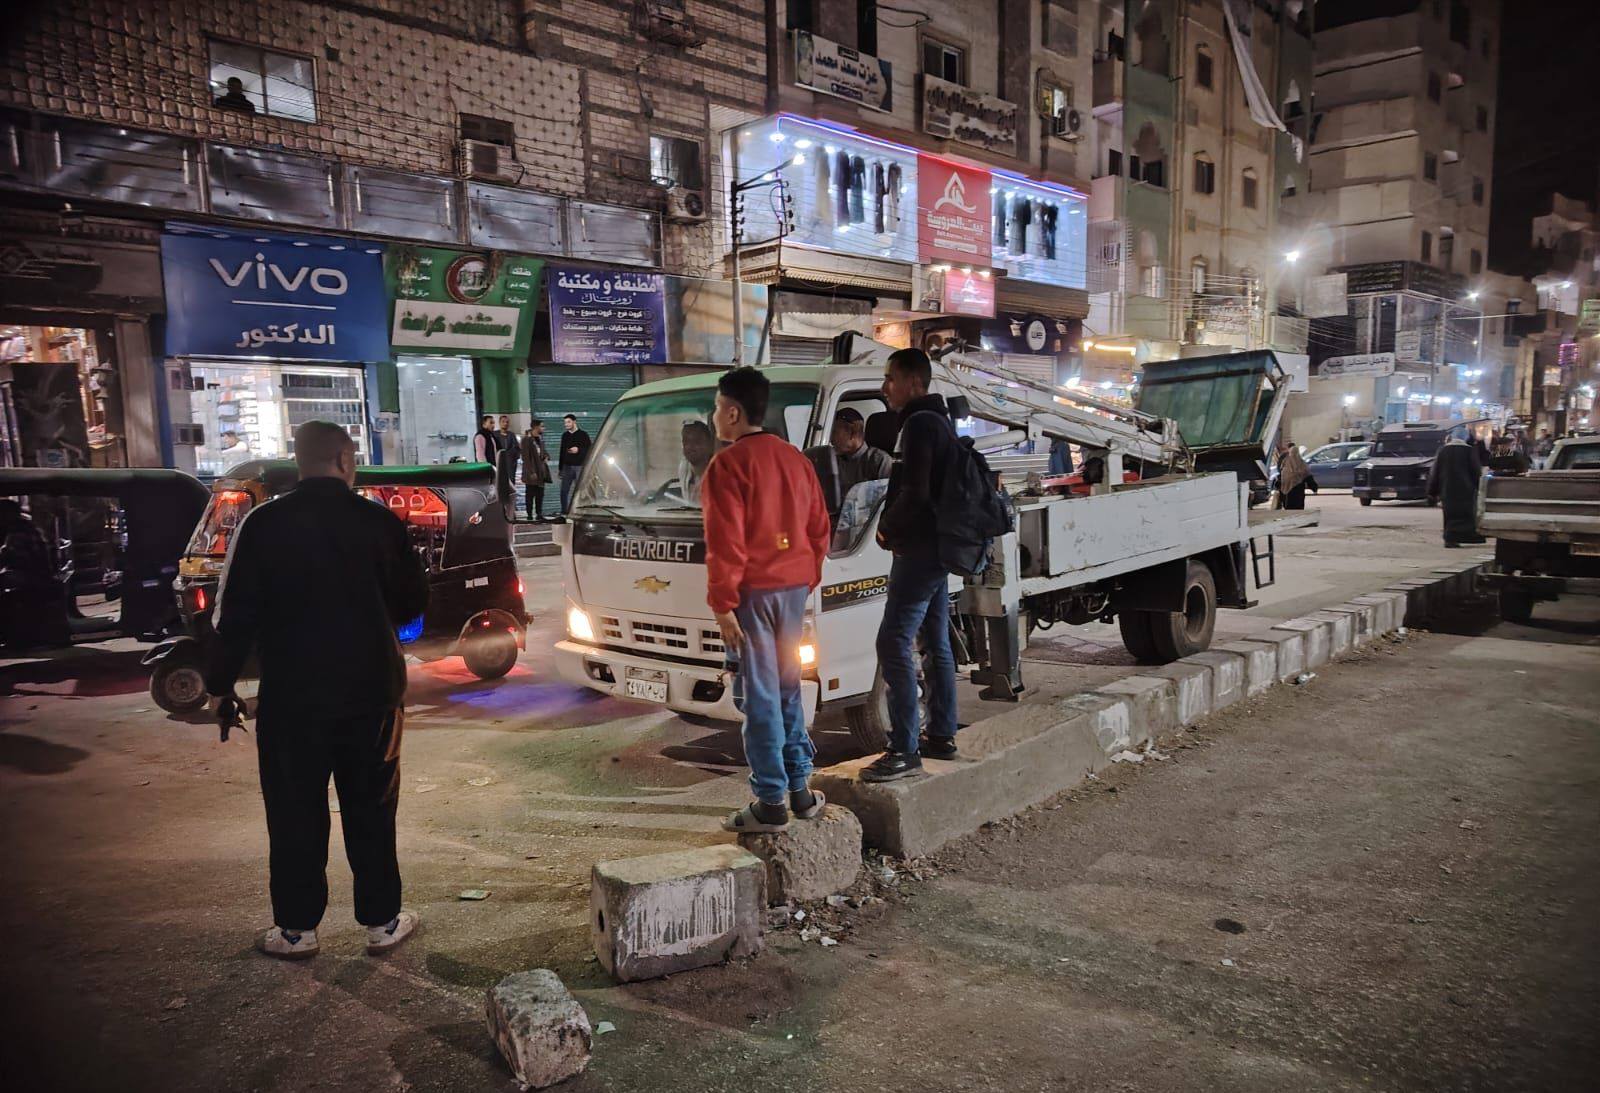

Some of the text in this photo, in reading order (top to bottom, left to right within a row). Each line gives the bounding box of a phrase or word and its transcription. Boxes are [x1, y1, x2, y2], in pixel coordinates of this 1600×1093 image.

[208, 252, 348, 296] vivo
[558, 272, 657, 297] مطبعة و مكتبة
[235, 323, 336, 348] الدكتور
[613, 538, 695, 562] CHEVROLET
[823, 577, 887, 597] JUMBO
[856, 586, 888, 599] 7000
